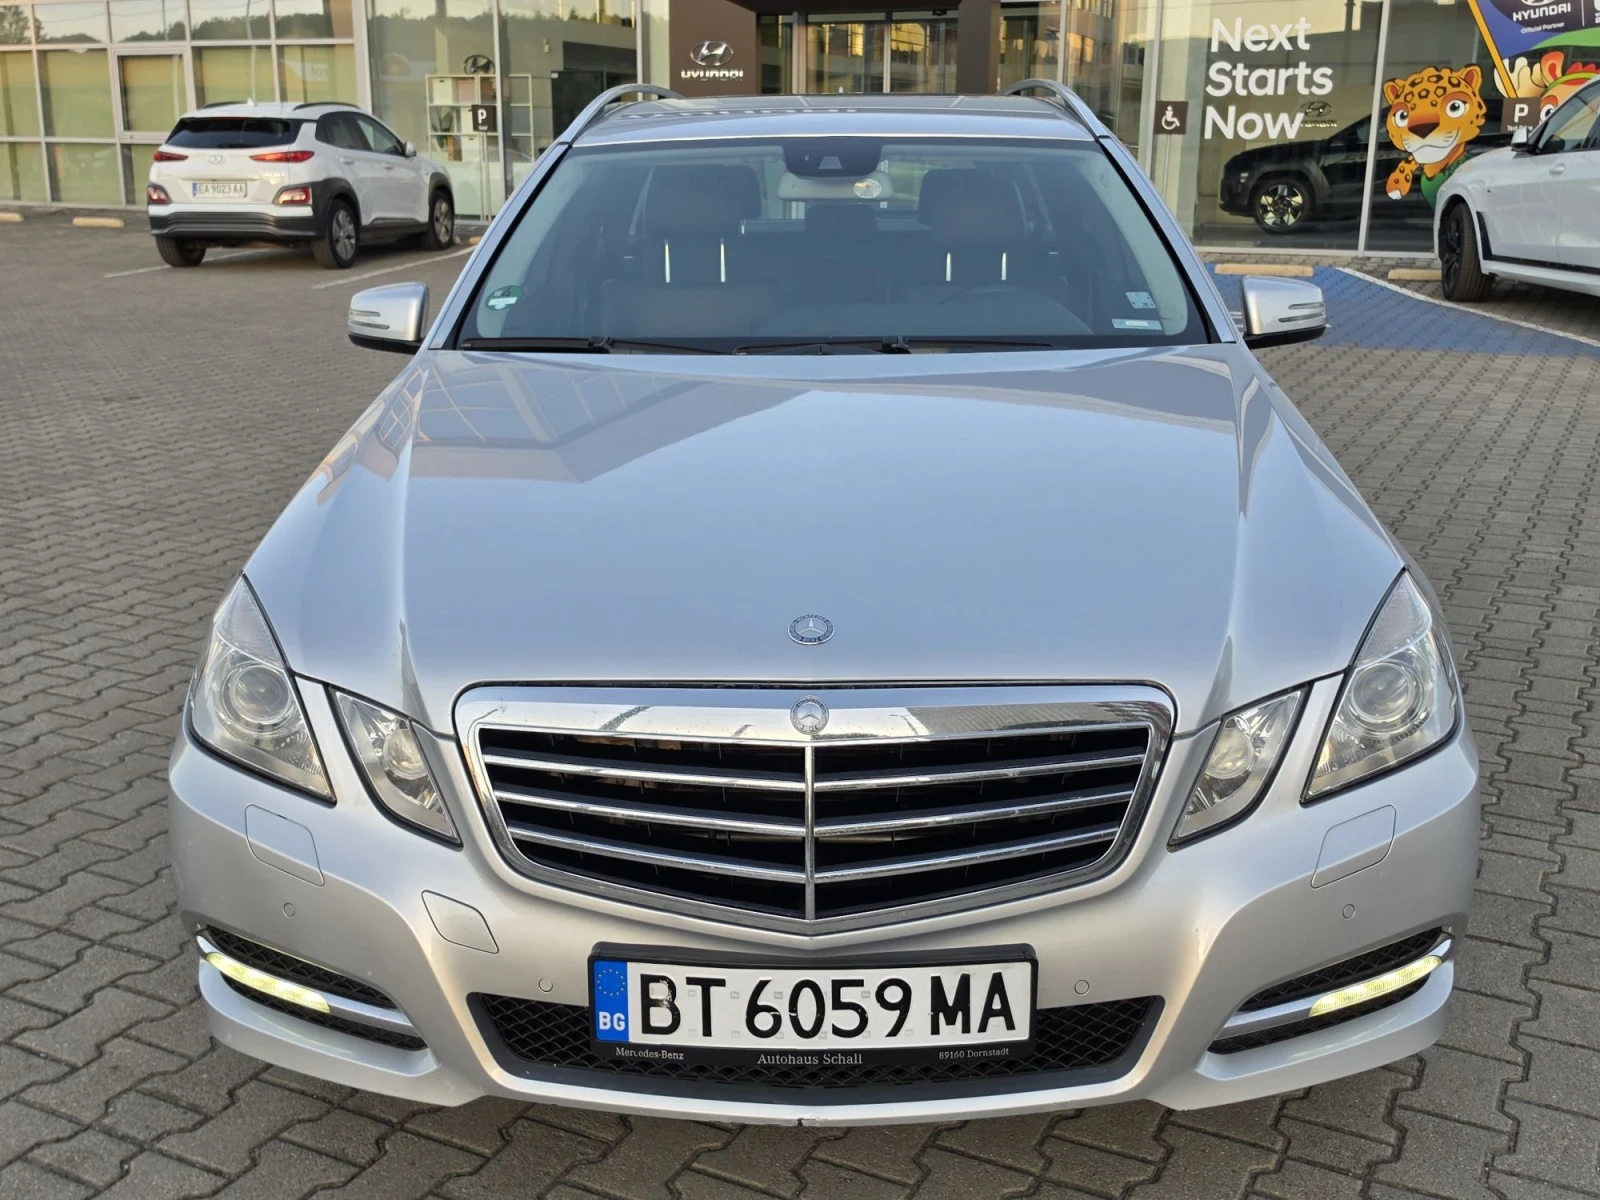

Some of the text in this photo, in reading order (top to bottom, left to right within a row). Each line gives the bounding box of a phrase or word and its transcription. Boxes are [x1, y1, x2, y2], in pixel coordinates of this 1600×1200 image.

[1512, 2, 1572, 22] HYUNDAI
[1210, 16, 1312, 52] Next
[1520, 22, 1565, 34] Official Partner
[1205, 61, 1333, 97] Starts
[477, 108, 487, 124] P
[1203, 105, 1305, 140] Now
[1513, 103, 1529, 123] P
[639, 972, 1016, 1039] BT 6059 MA
[598, 1011, 626, 1031] BG
[757, 1053, 863, 1065] Autohaus Schall
[938, 1048, 1009, 1060] 89160 Dornstadt
